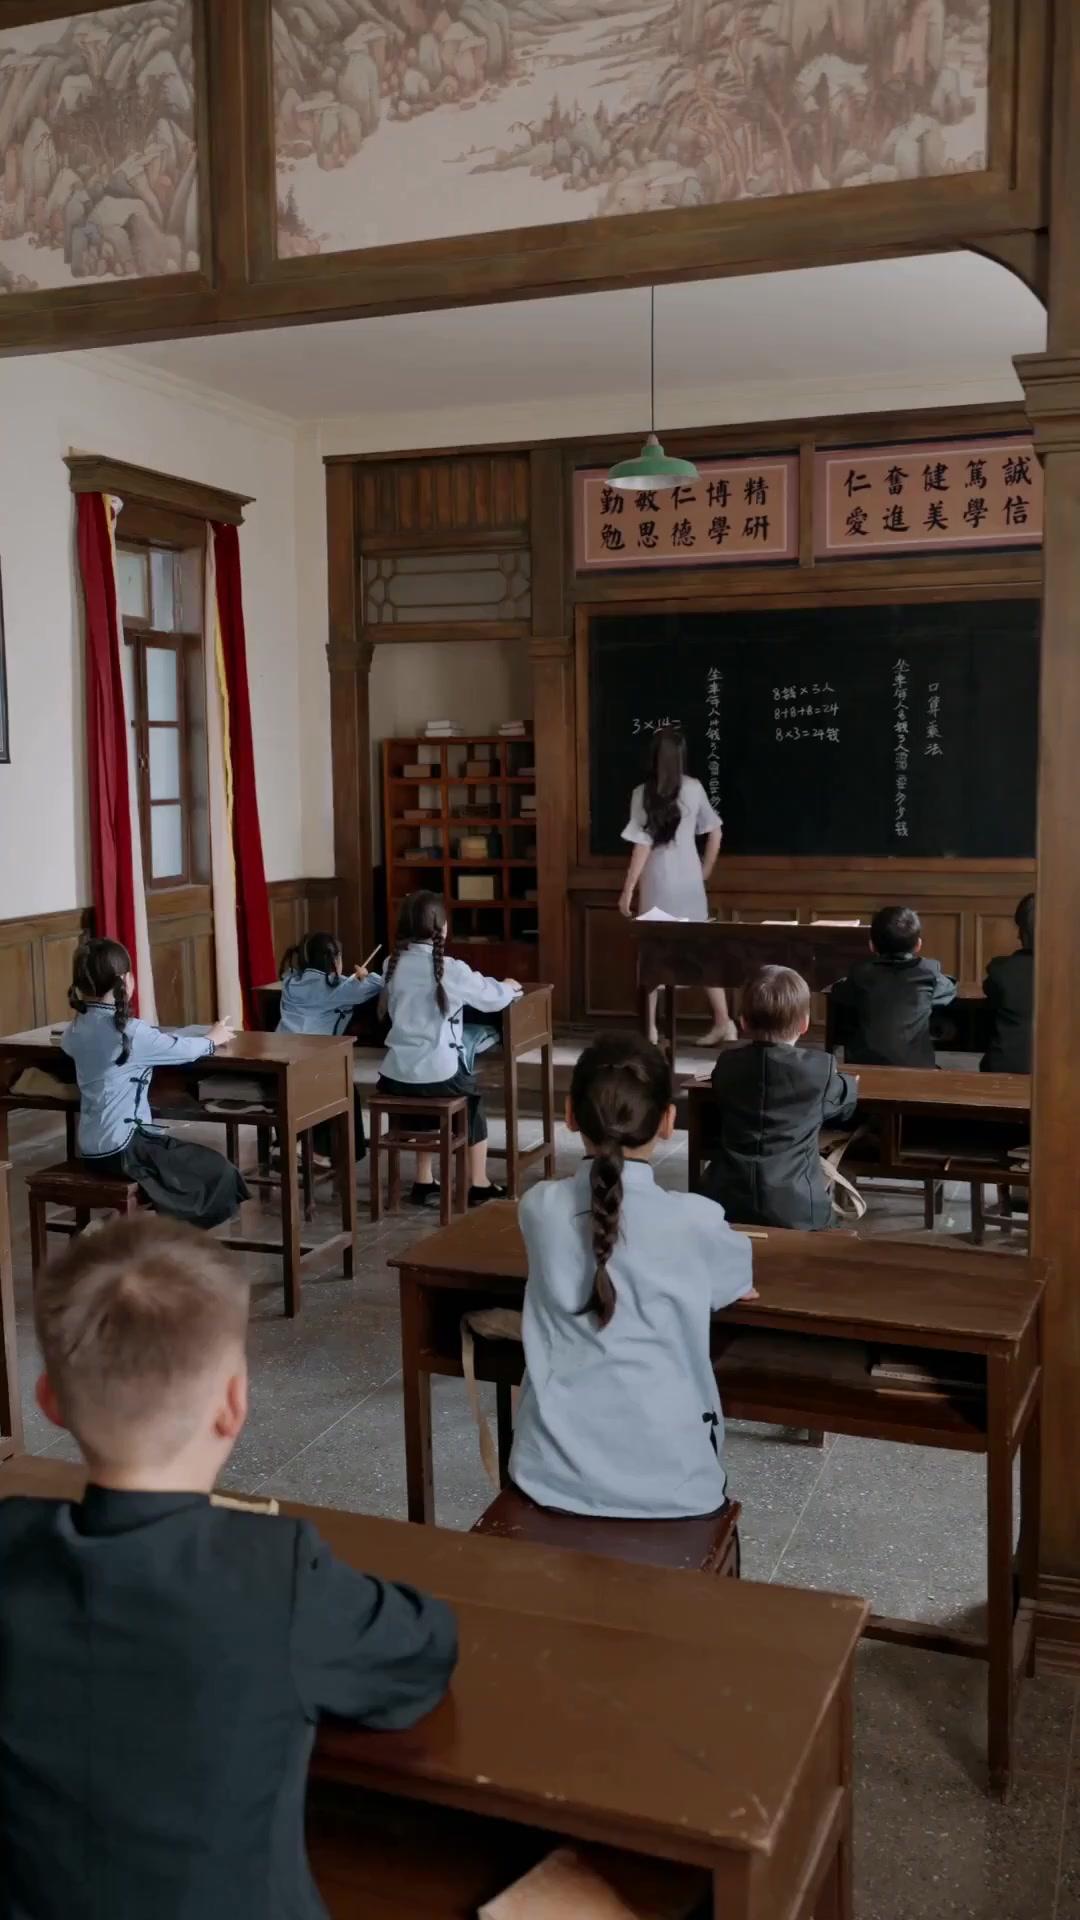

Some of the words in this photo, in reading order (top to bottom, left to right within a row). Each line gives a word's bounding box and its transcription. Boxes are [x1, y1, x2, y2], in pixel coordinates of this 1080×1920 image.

[600, 487, 626, 550] 勤勉
[634, 489, 660, 548] 敏思
[671, 486, 696, 547] 仁德
[706, 480, 732, 545] 博學
[844, 469, 872, 536] 仁愛
[882, 465, 910, 532] 奮進
[923, 462, 949, 531] 健美
[963, 459, 988, 528] 篤學
[1001, 456, 1033, 525] 誠信
